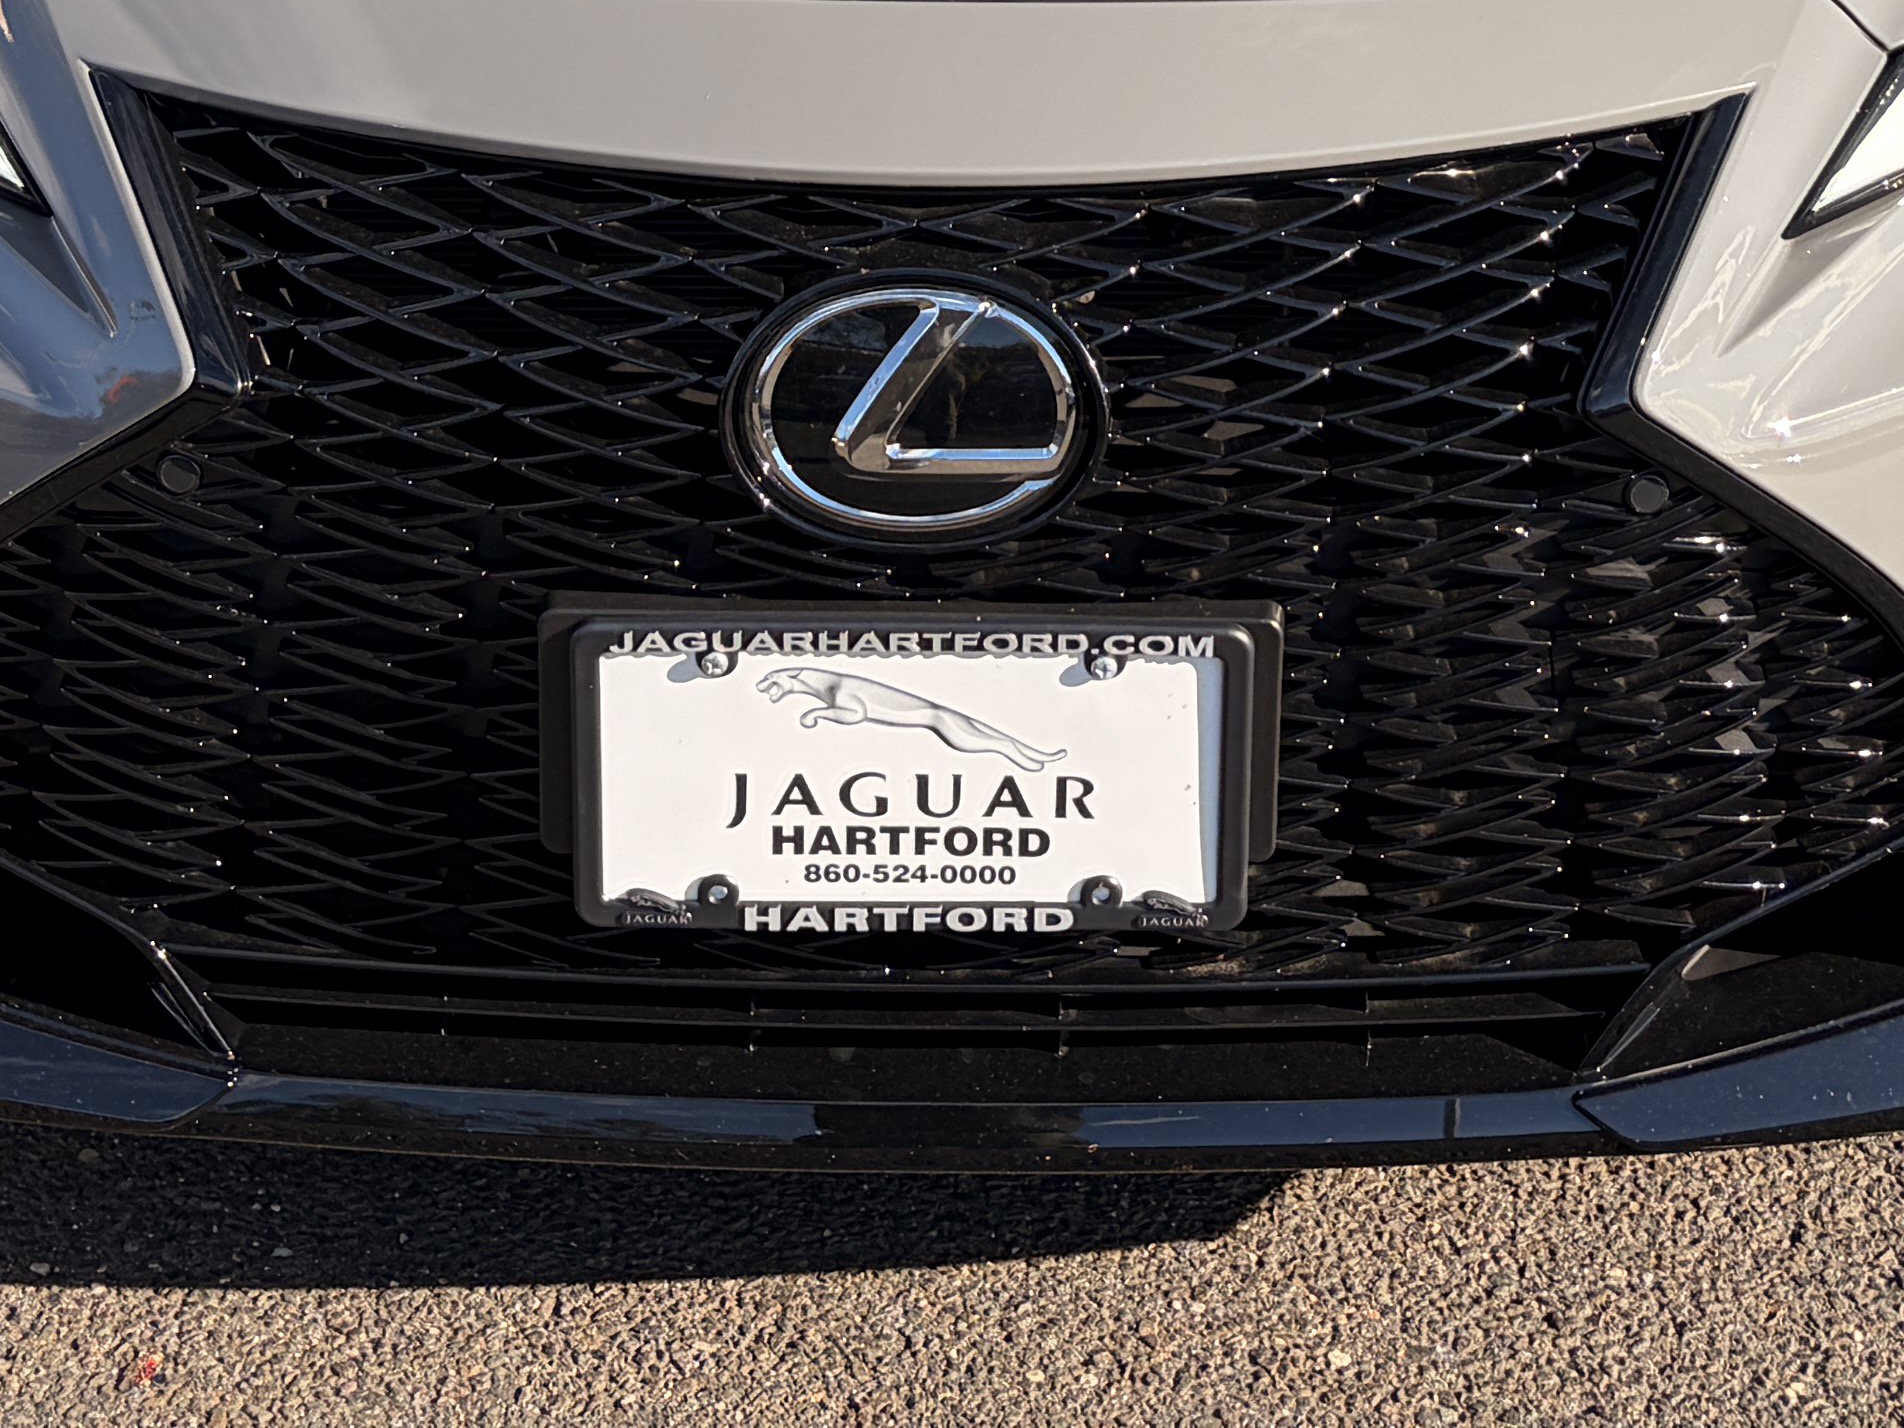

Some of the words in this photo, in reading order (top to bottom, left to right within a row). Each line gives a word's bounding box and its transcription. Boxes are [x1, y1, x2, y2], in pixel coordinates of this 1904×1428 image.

[609, 629, 1215, 658] JAGUARHARTFORD.COM
[725, 770, 1095, 829] JAGUAR
[771, 824, 1051, 857] HARTFORD
[803, 863, 1017, 885] 860-524-0000
[623, 912, 691, 925] JAGUAR
[743, 902, 1075, 933] HARTFORD
[1140, 915, 1209, 928] JAGUAR
